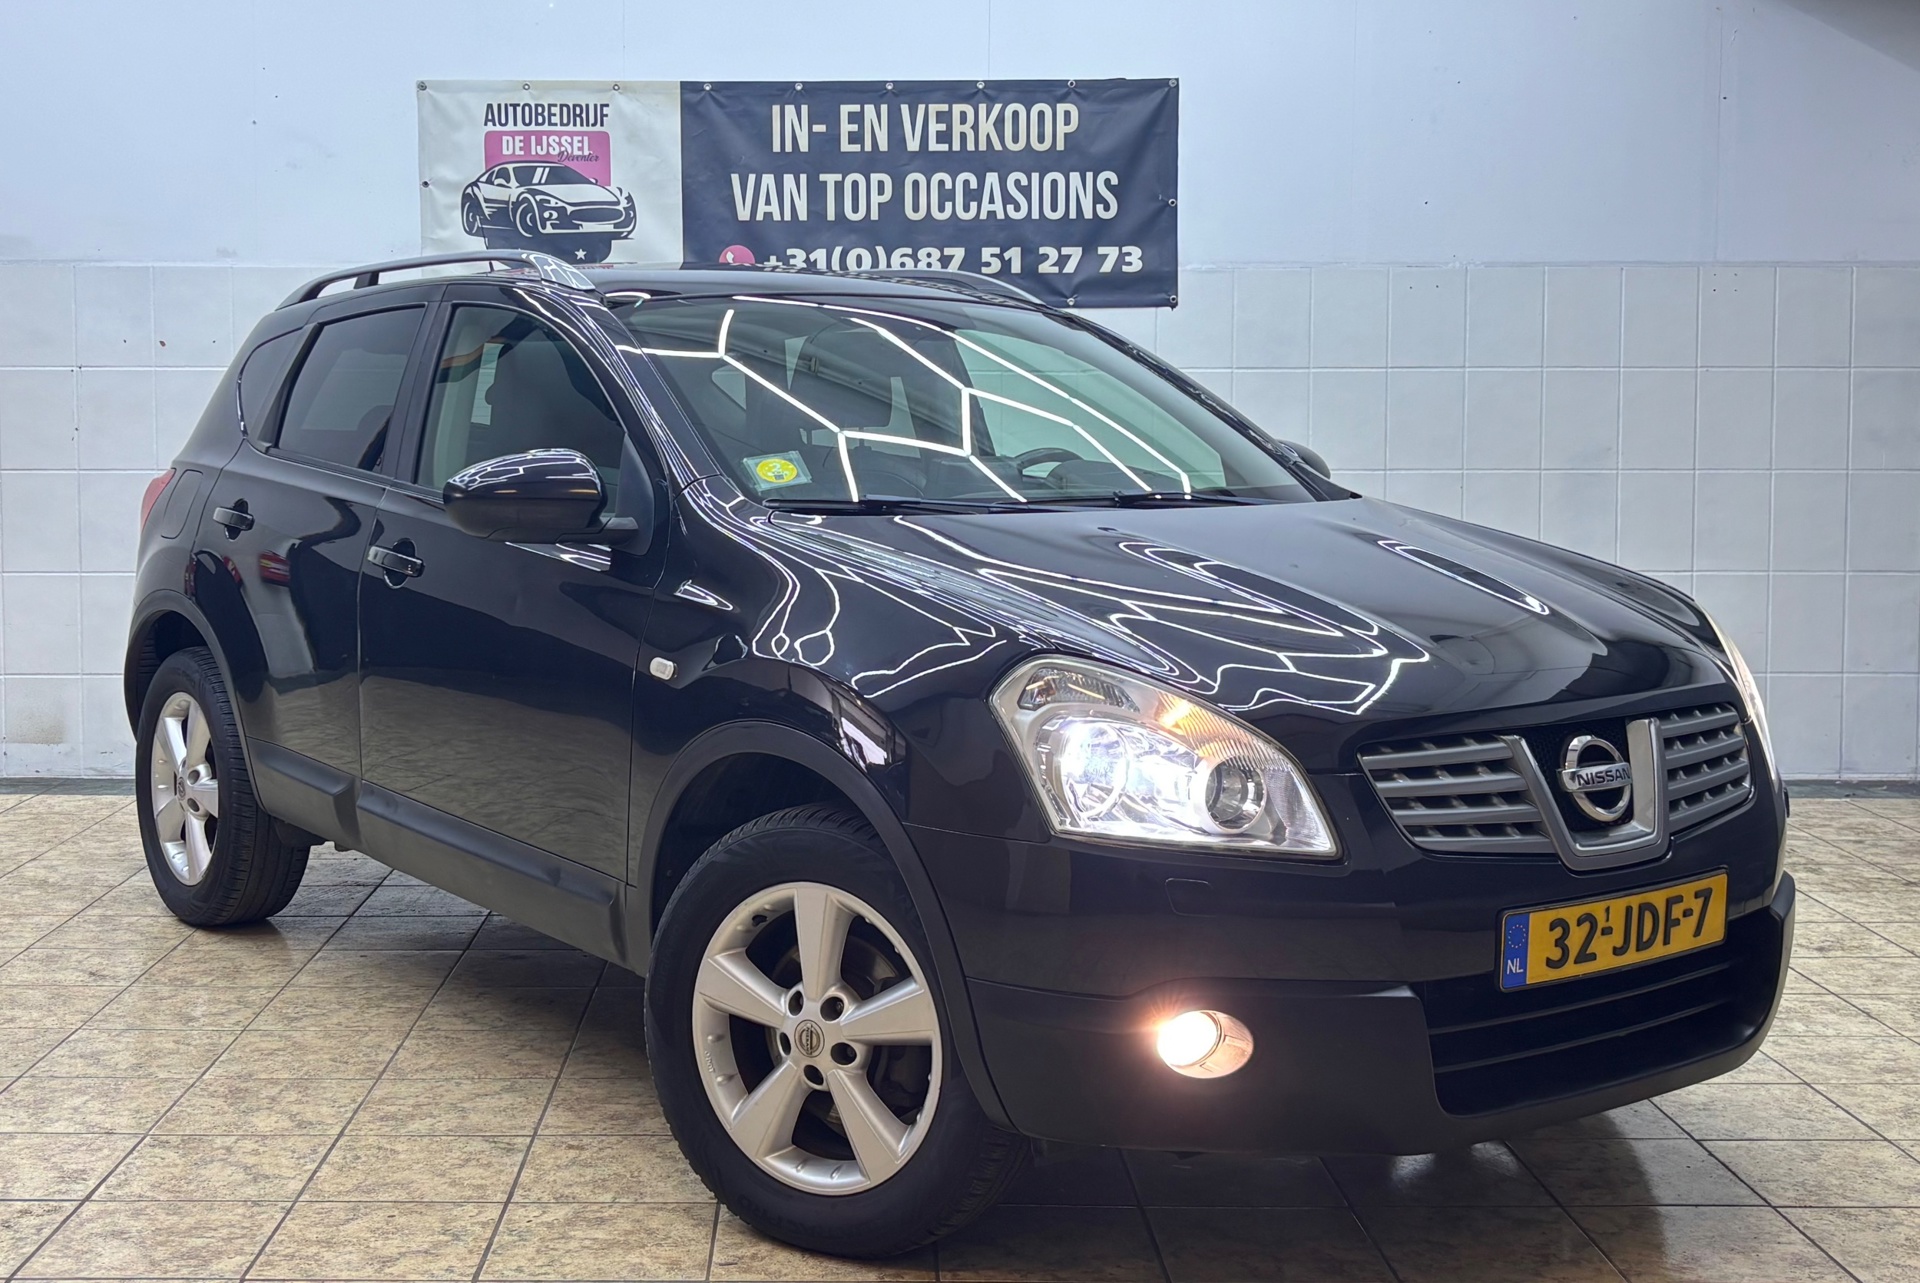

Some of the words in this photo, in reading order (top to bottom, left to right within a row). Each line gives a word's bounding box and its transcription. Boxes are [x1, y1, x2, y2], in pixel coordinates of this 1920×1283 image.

[484, 103, 610, 127] AUTOBEDRIJF
[771, 104, 827, 153] IN-
[839, 104, 889, 152] EN
[900, 102, 1080, 152] VERKOOP
[502, 135, 524, 155] DE
[531, 135, 593, 156] IJSSEL
[557, 150, 600, 163] Deventer
[730, 172, 808, 221] VAN
[819, 172, 893, 220] TOP
[904, 170, 1119, 220] OCCASIONS
[763, 245, 966, 272] +31(0)687
[980, 247, 1022, 273] 51
[1038, 246, 1084, 273] 27
[1097, 245, 1144, 273] 73
[1576, 767, 1631, 786] NISSAN
[1506, 958, 1524, 975] NL
